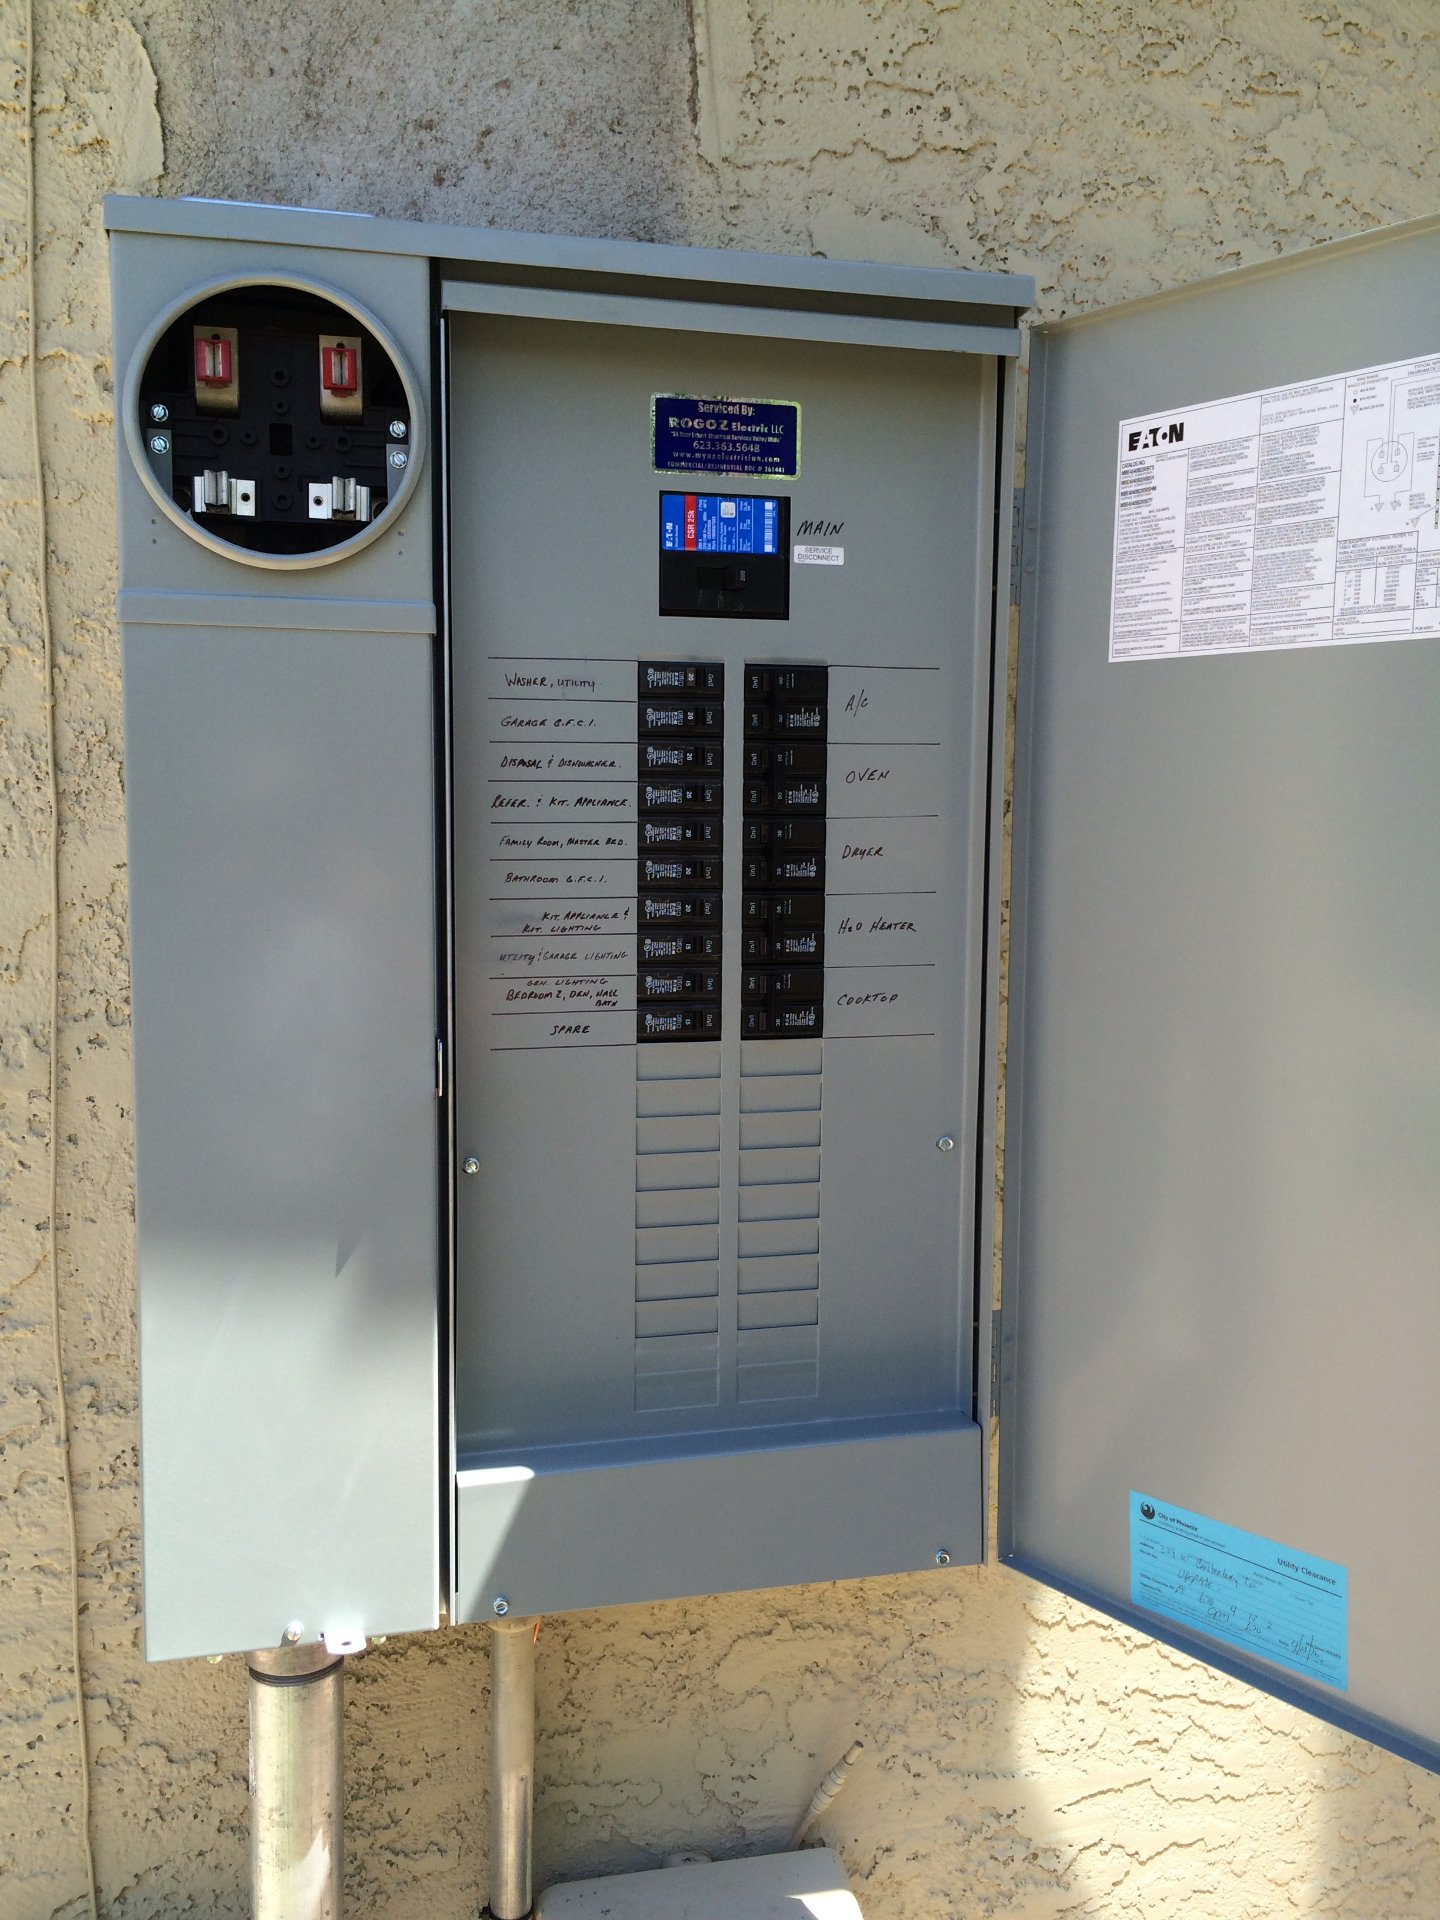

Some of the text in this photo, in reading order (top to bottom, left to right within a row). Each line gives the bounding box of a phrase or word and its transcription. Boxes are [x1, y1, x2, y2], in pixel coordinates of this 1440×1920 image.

[698, 402, 756, 417] Serviced By:
[731, 421, 769, 433] Electric
[771, 424, 784, 434] LLC
[1128, 422, 1185, 452] EATON
[693, 440, 760, 453] 623.363.5648
[665, 522, 673, 547] EATON
[687, 524, 695, 539] CSR
[796, 520, 845, 537] MAIN
[804, 546, 833, 555] SERVICE
[797, 553, 841, 562] DISCONNECT
[505, 672, 554, 688] WASHER,
[688, 673, 695, 681] 20
[845, 688, 869, 718] A/C
[500, 715, 548, 728] GARAGE
[687, 711, 694, 720] 20
[500, 755, 543, 769] DISPOSAL
[686, 752, 693, 761] 20
[845, 767, 890, 784] OVEN
[686, 790, 692, 799] 20
[548, 796, 570, 807] KIT.
[685, 829, 692, 838] 20
[500, 835, 628, 849] FAMILY ROOM, MASTER BED.
[841, 844, 884, 860] DRYER
[685, 867, 692, 876] 20
[504, 872, 559, 884] BATHROOM
[685, 904, 691, 913] 20
[541, 911, 560, 921] KIT.
[563, 910, 620, 920] APPLIANCE
[550, 924, 602, 933] LIGHTING
[869, 916, 917, 934] HEATER
[543, 950, 578, 961] GARAGE
[584, 950, 629, 961] LIGHTING
[554, 977, 609, 985] LIGHTING
[505, 988, 553, 1001] BEDROOM
[569, 989, 593, 1000] DEN,
[595, 988, 619, 998] HALL
[837, 992, 899, 1006] COOKTOP
[594, 999, 618, 1007] BATH
[549, 1024, 591, 1036] SPARE
[1176, 1519, 1198, 1531] Phoenix
[1277, 1557, 1300, 1573] Utility
[1301, 1567, 1336, 1586] Clearance
